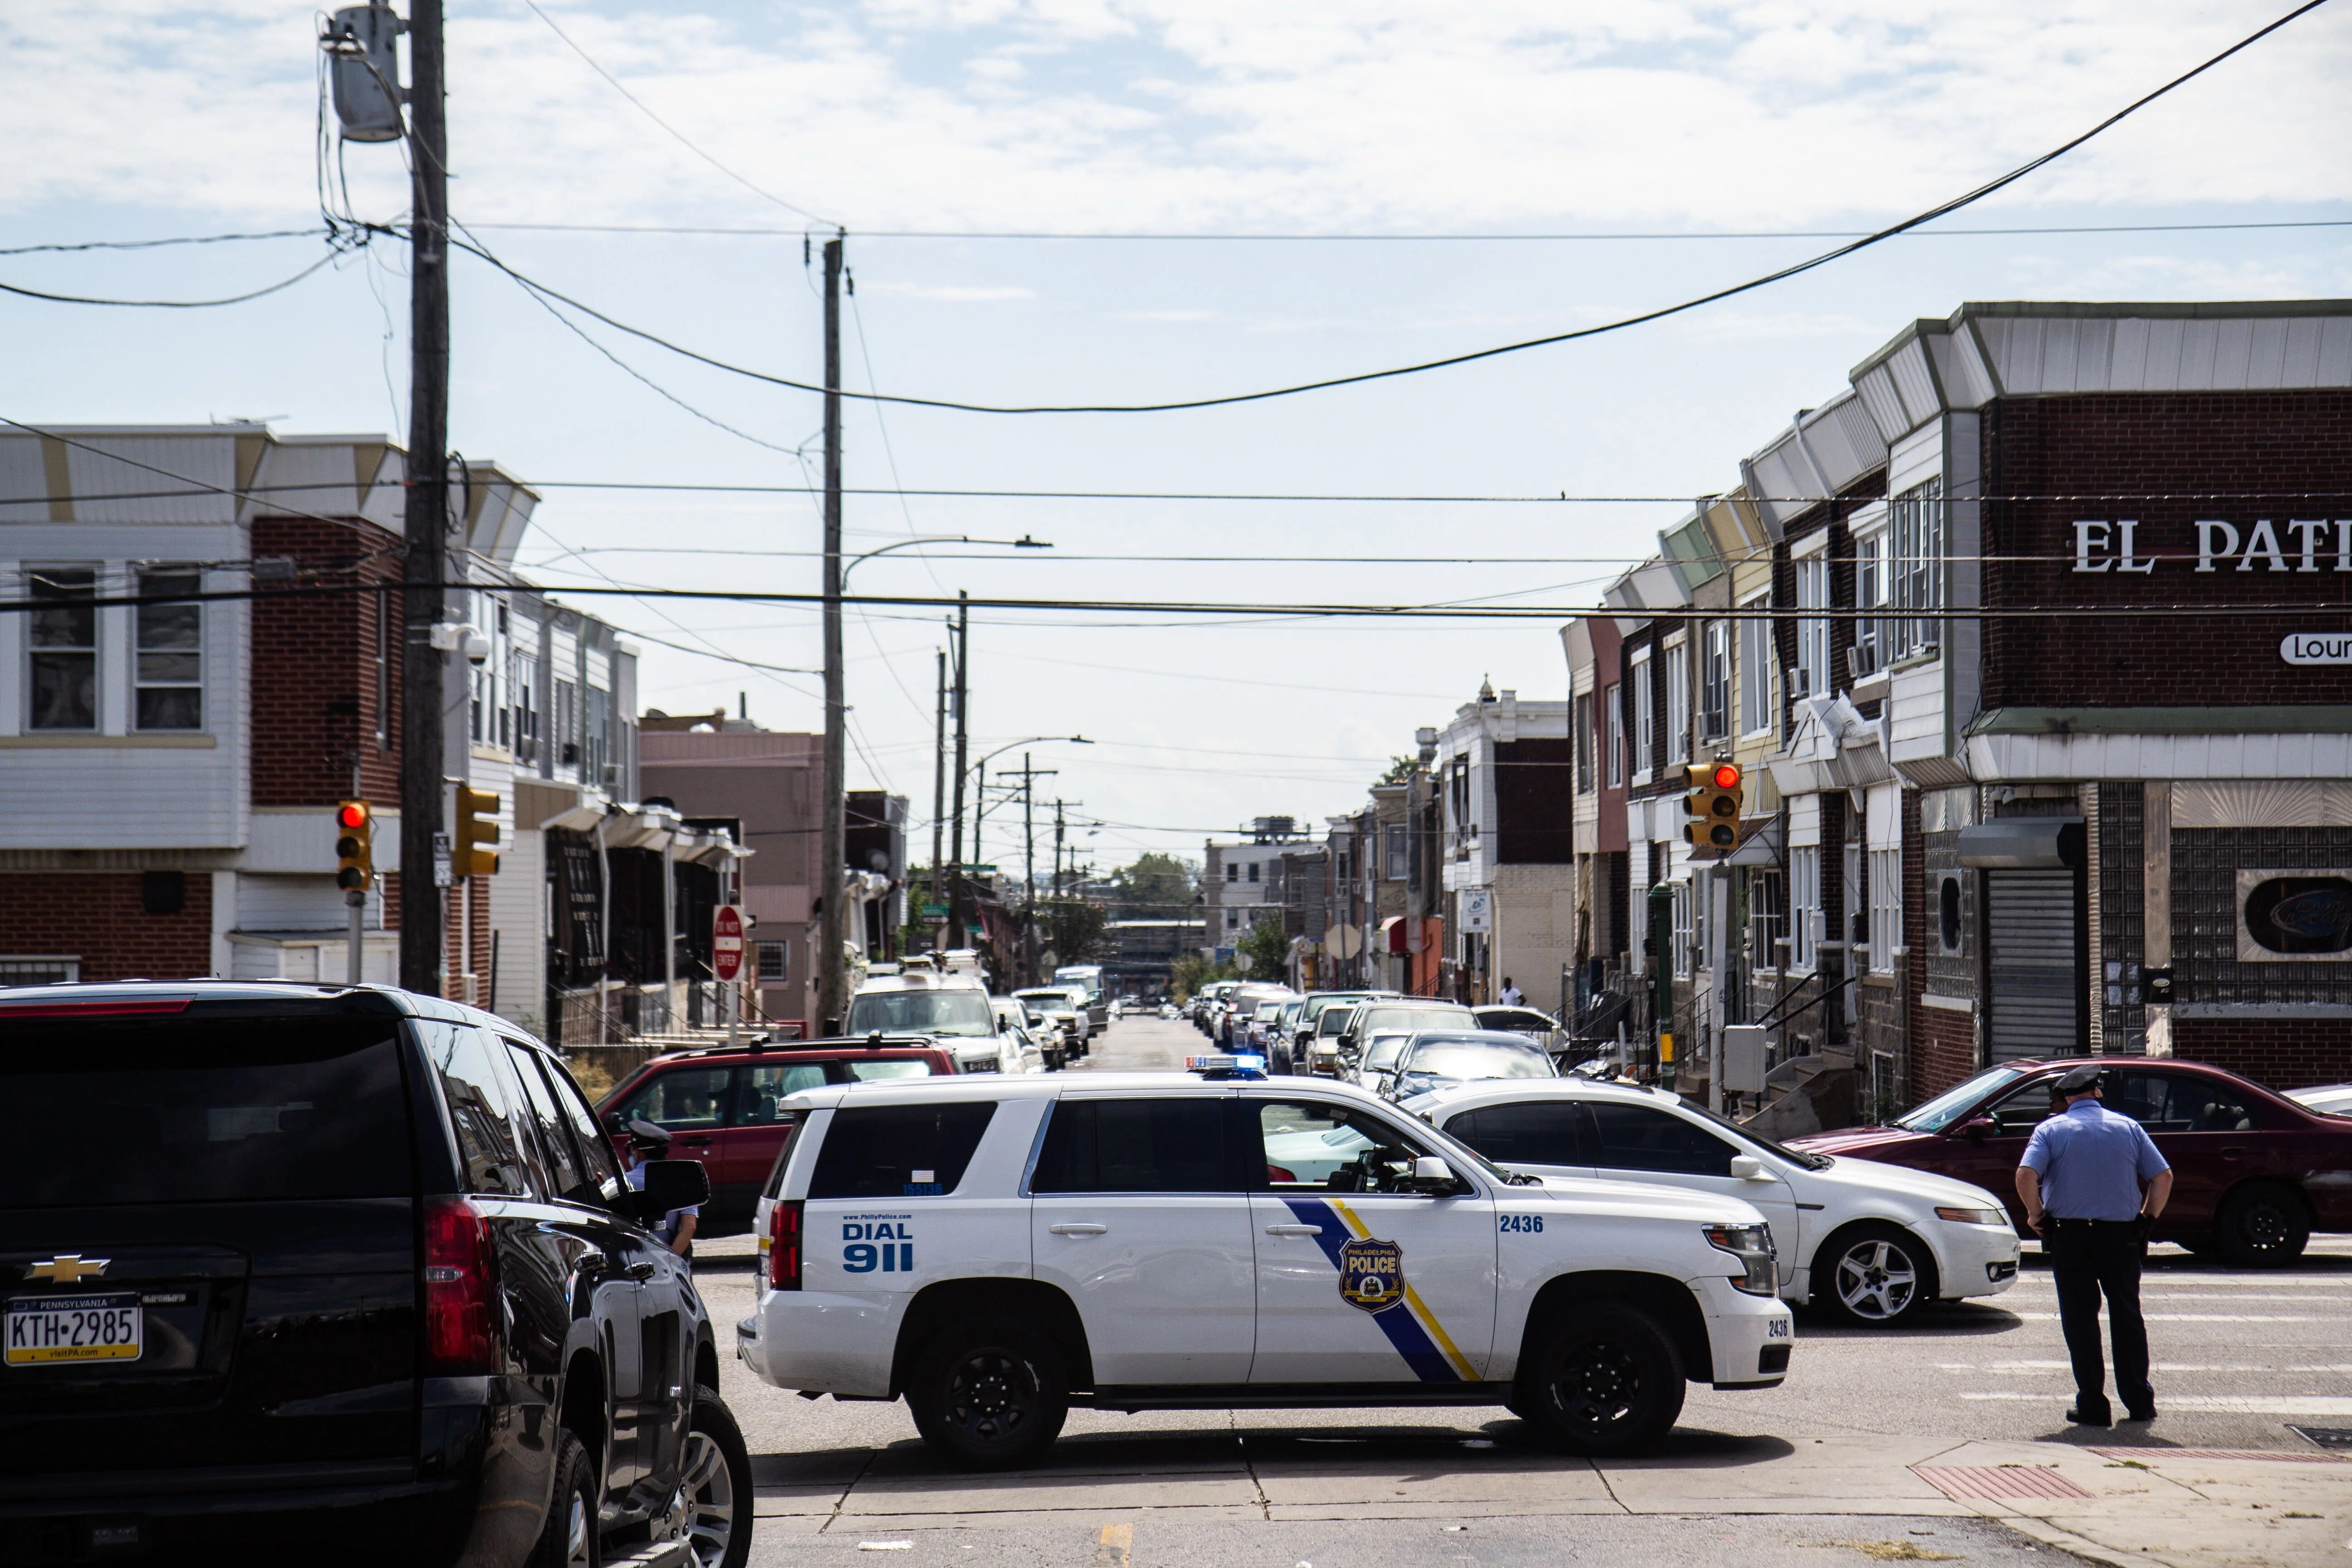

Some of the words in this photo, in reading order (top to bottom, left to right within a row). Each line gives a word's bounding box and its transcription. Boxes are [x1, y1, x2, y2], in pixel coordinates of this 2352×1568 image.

[2072, 519, 2156, 574] EL
[718, 921, 724, 932] DO
[726, 921, 739, 933] NOT
[718, 955, 736, 966] ENTER
[903, 1183, 943, 1196] 155136
[843, 1223, 913, 1240] DIAL
[1500, 1215, 1544, 1233] 2436
[843, 1243, 913, 1273] 911
[1349, 1257, 1396, 1273] POLICE
[40, 1299, 107, 1309] PENNSYLVANIA
[1769, 1319, 1788, 1338] 2436
[49, 1349, 98, 1357] visitPA.com
